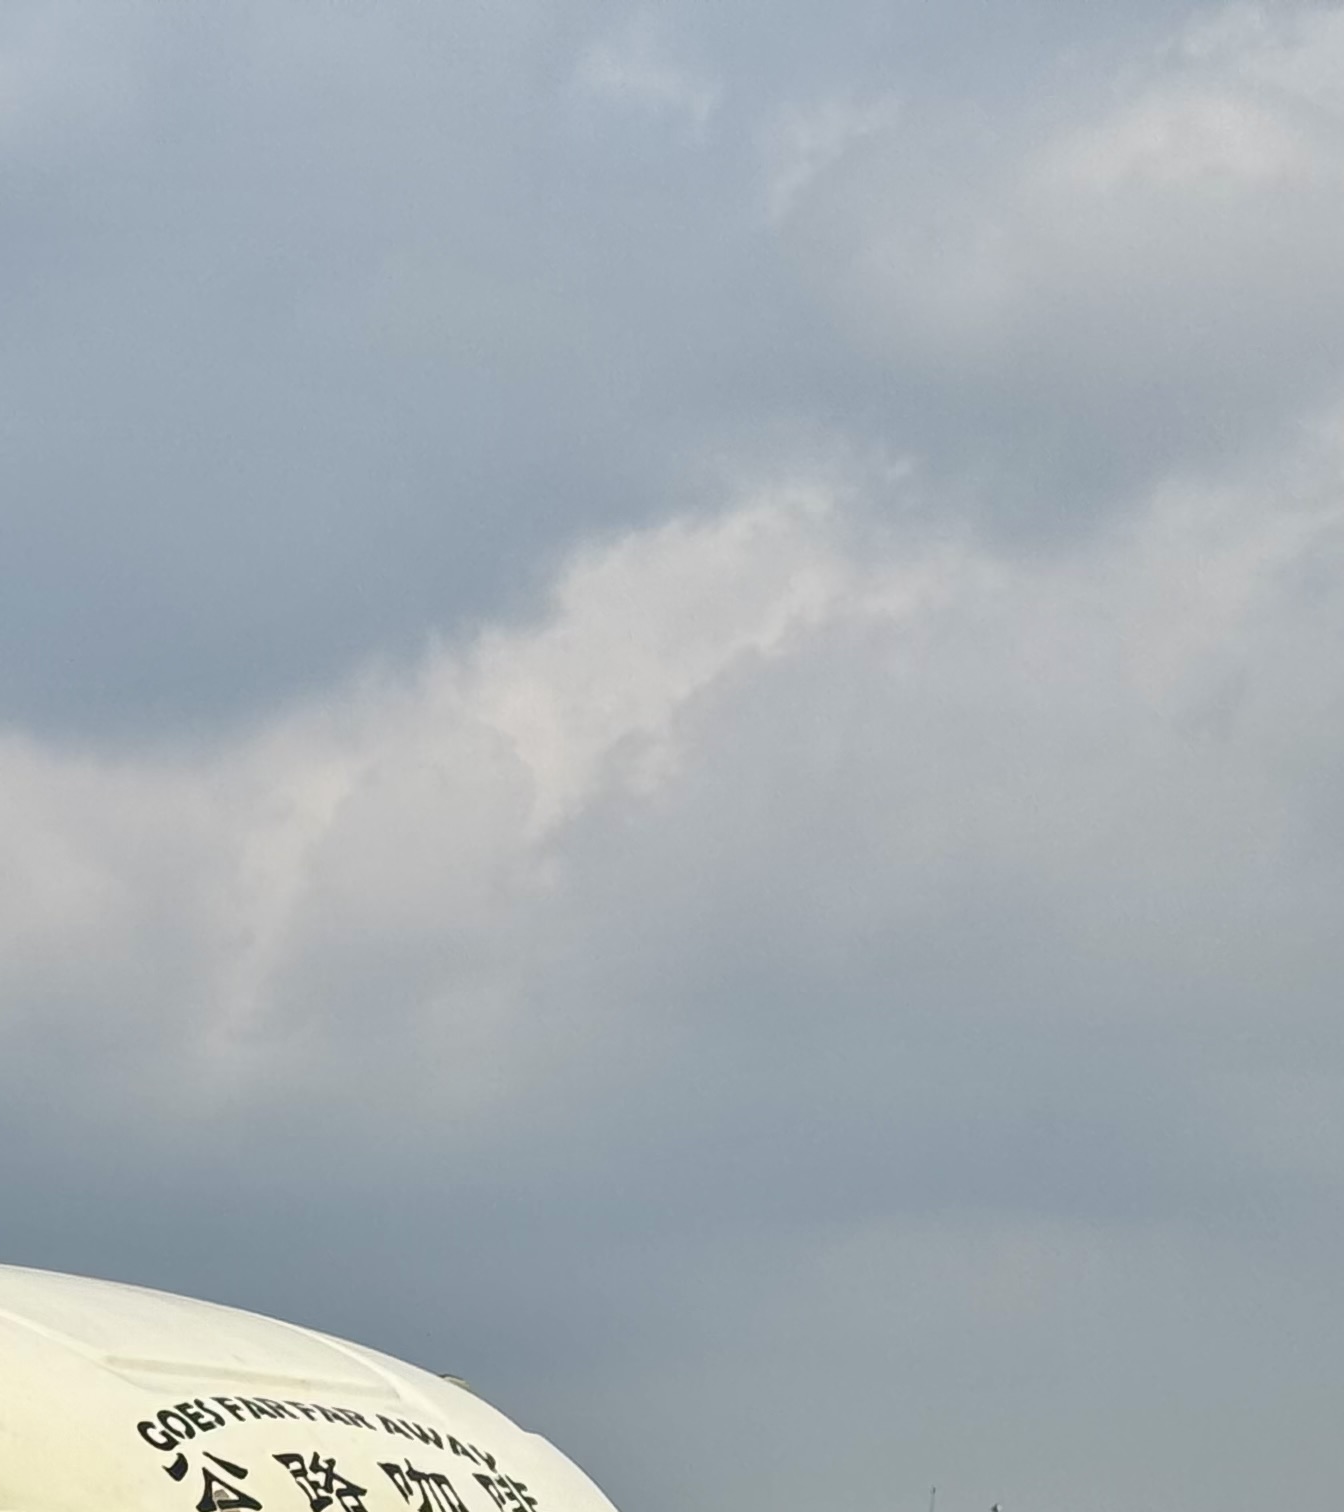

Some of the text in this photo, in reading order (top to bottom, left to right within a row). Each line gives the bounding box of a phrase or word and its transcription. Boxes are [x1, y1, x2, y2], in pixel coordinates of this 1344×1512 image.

[137, 1396, 497, 1473] GOES FAR FAR AWAY
